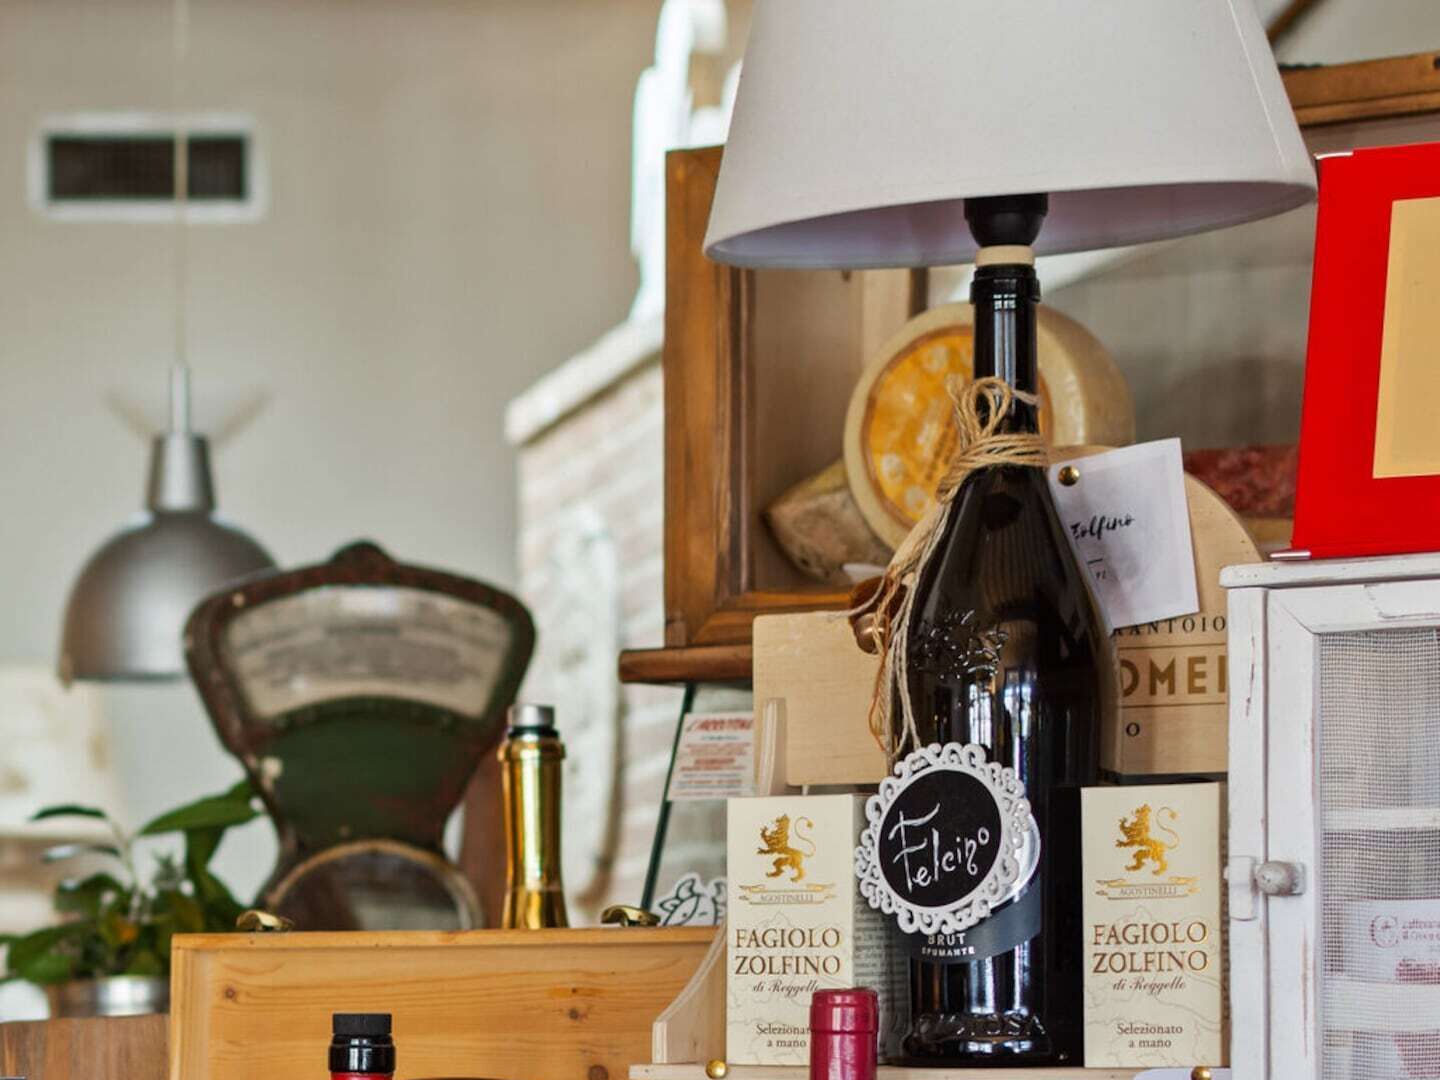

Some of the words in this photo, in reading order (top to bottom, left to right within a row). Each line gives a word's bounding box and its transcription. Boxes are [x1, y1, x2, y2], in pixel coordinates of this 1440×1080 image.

[735, 927, 841, 949] FAGIOLO
[927, 932, 968, 947] BRUT
[1093, 921, 1208, 945] FAGIOLO
[735, 954, 841, 976] ZOLFINO
[1093, 949, 1208, 974] ZOLFINO
[753, 979, 764, 993] di
[1112, 977, 1126, 991] di
[1116, 1022, 1183, 1036] Selezionato
[776, 1039, 808, 1049] mano
[1138, 1039, 1172, 1049] mano
